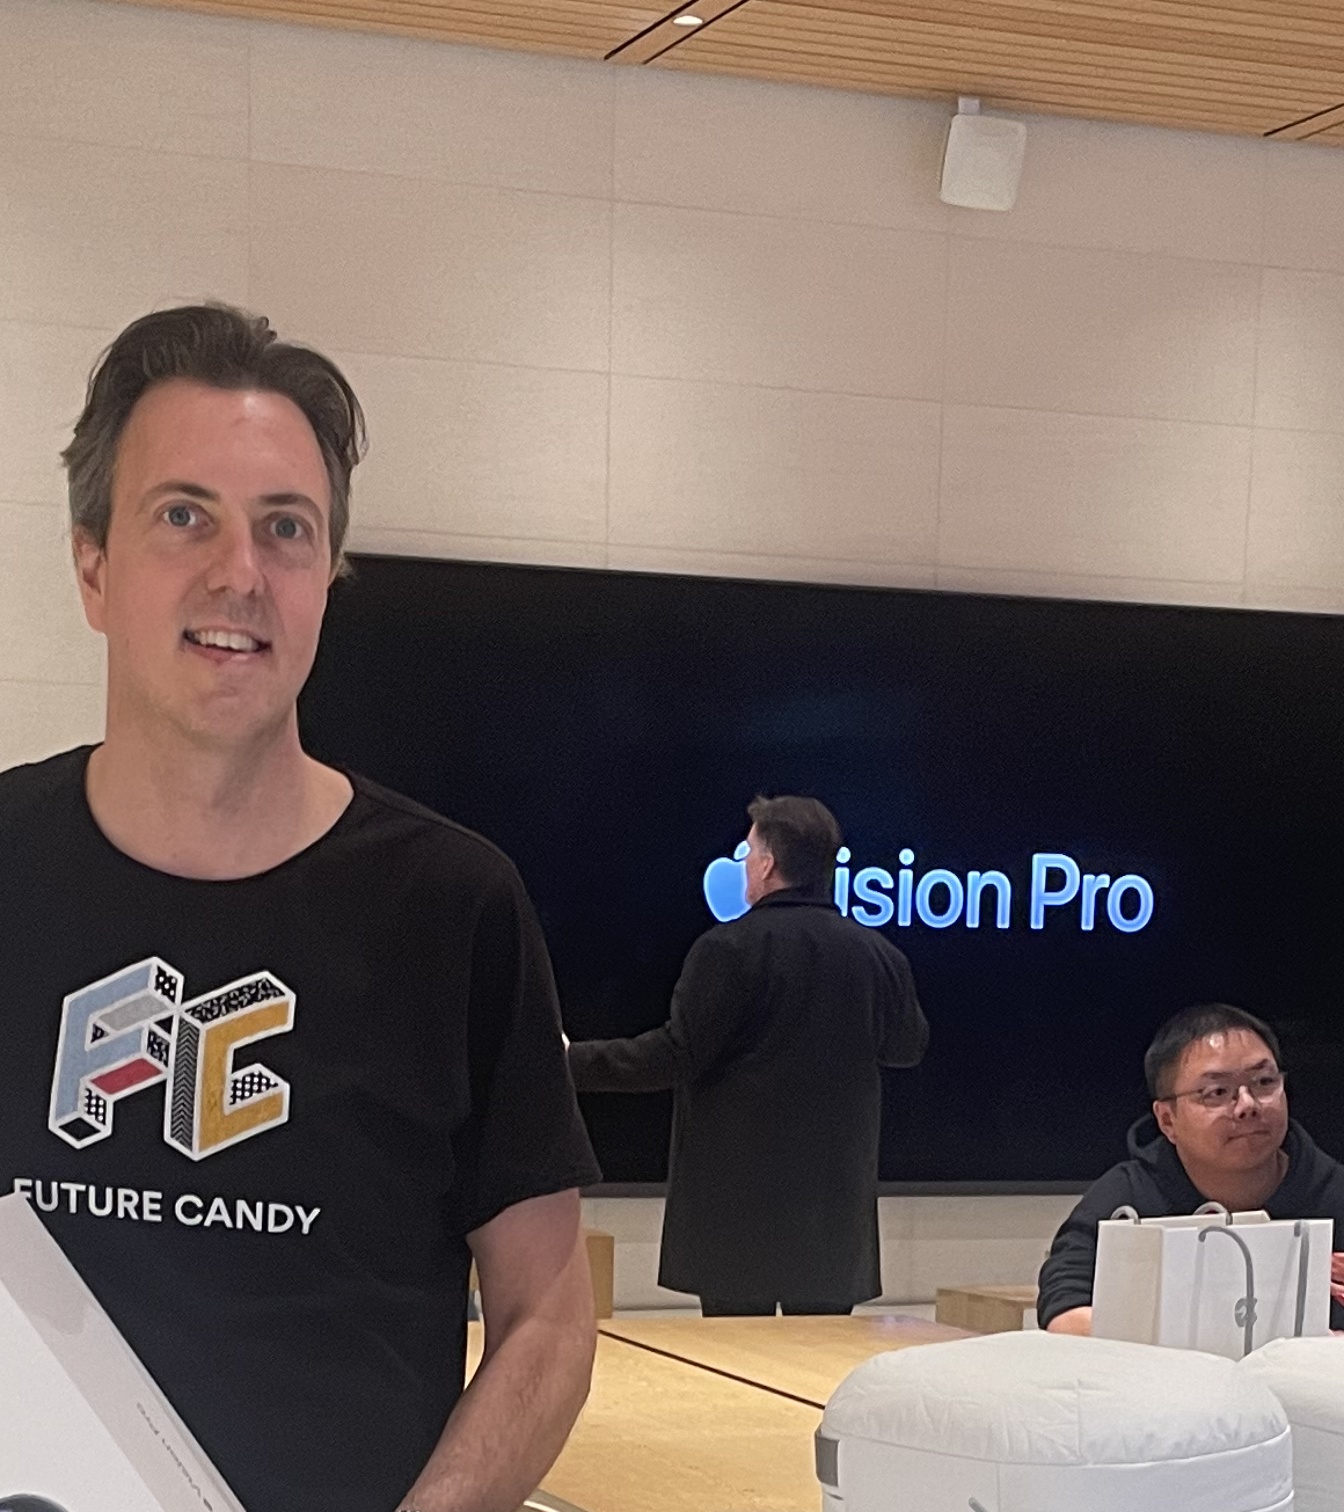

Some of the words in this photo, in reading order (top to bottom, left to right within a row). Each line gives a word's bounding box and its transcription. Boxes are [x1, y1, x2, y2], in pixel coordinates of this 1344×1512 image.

[834, 846, 1012, 928] ision
[1030, 852, 1155, 933] Pro
[13, 1178, 163, 1222] FUTURE
[173, 1194, 321, 1235] CANDY
